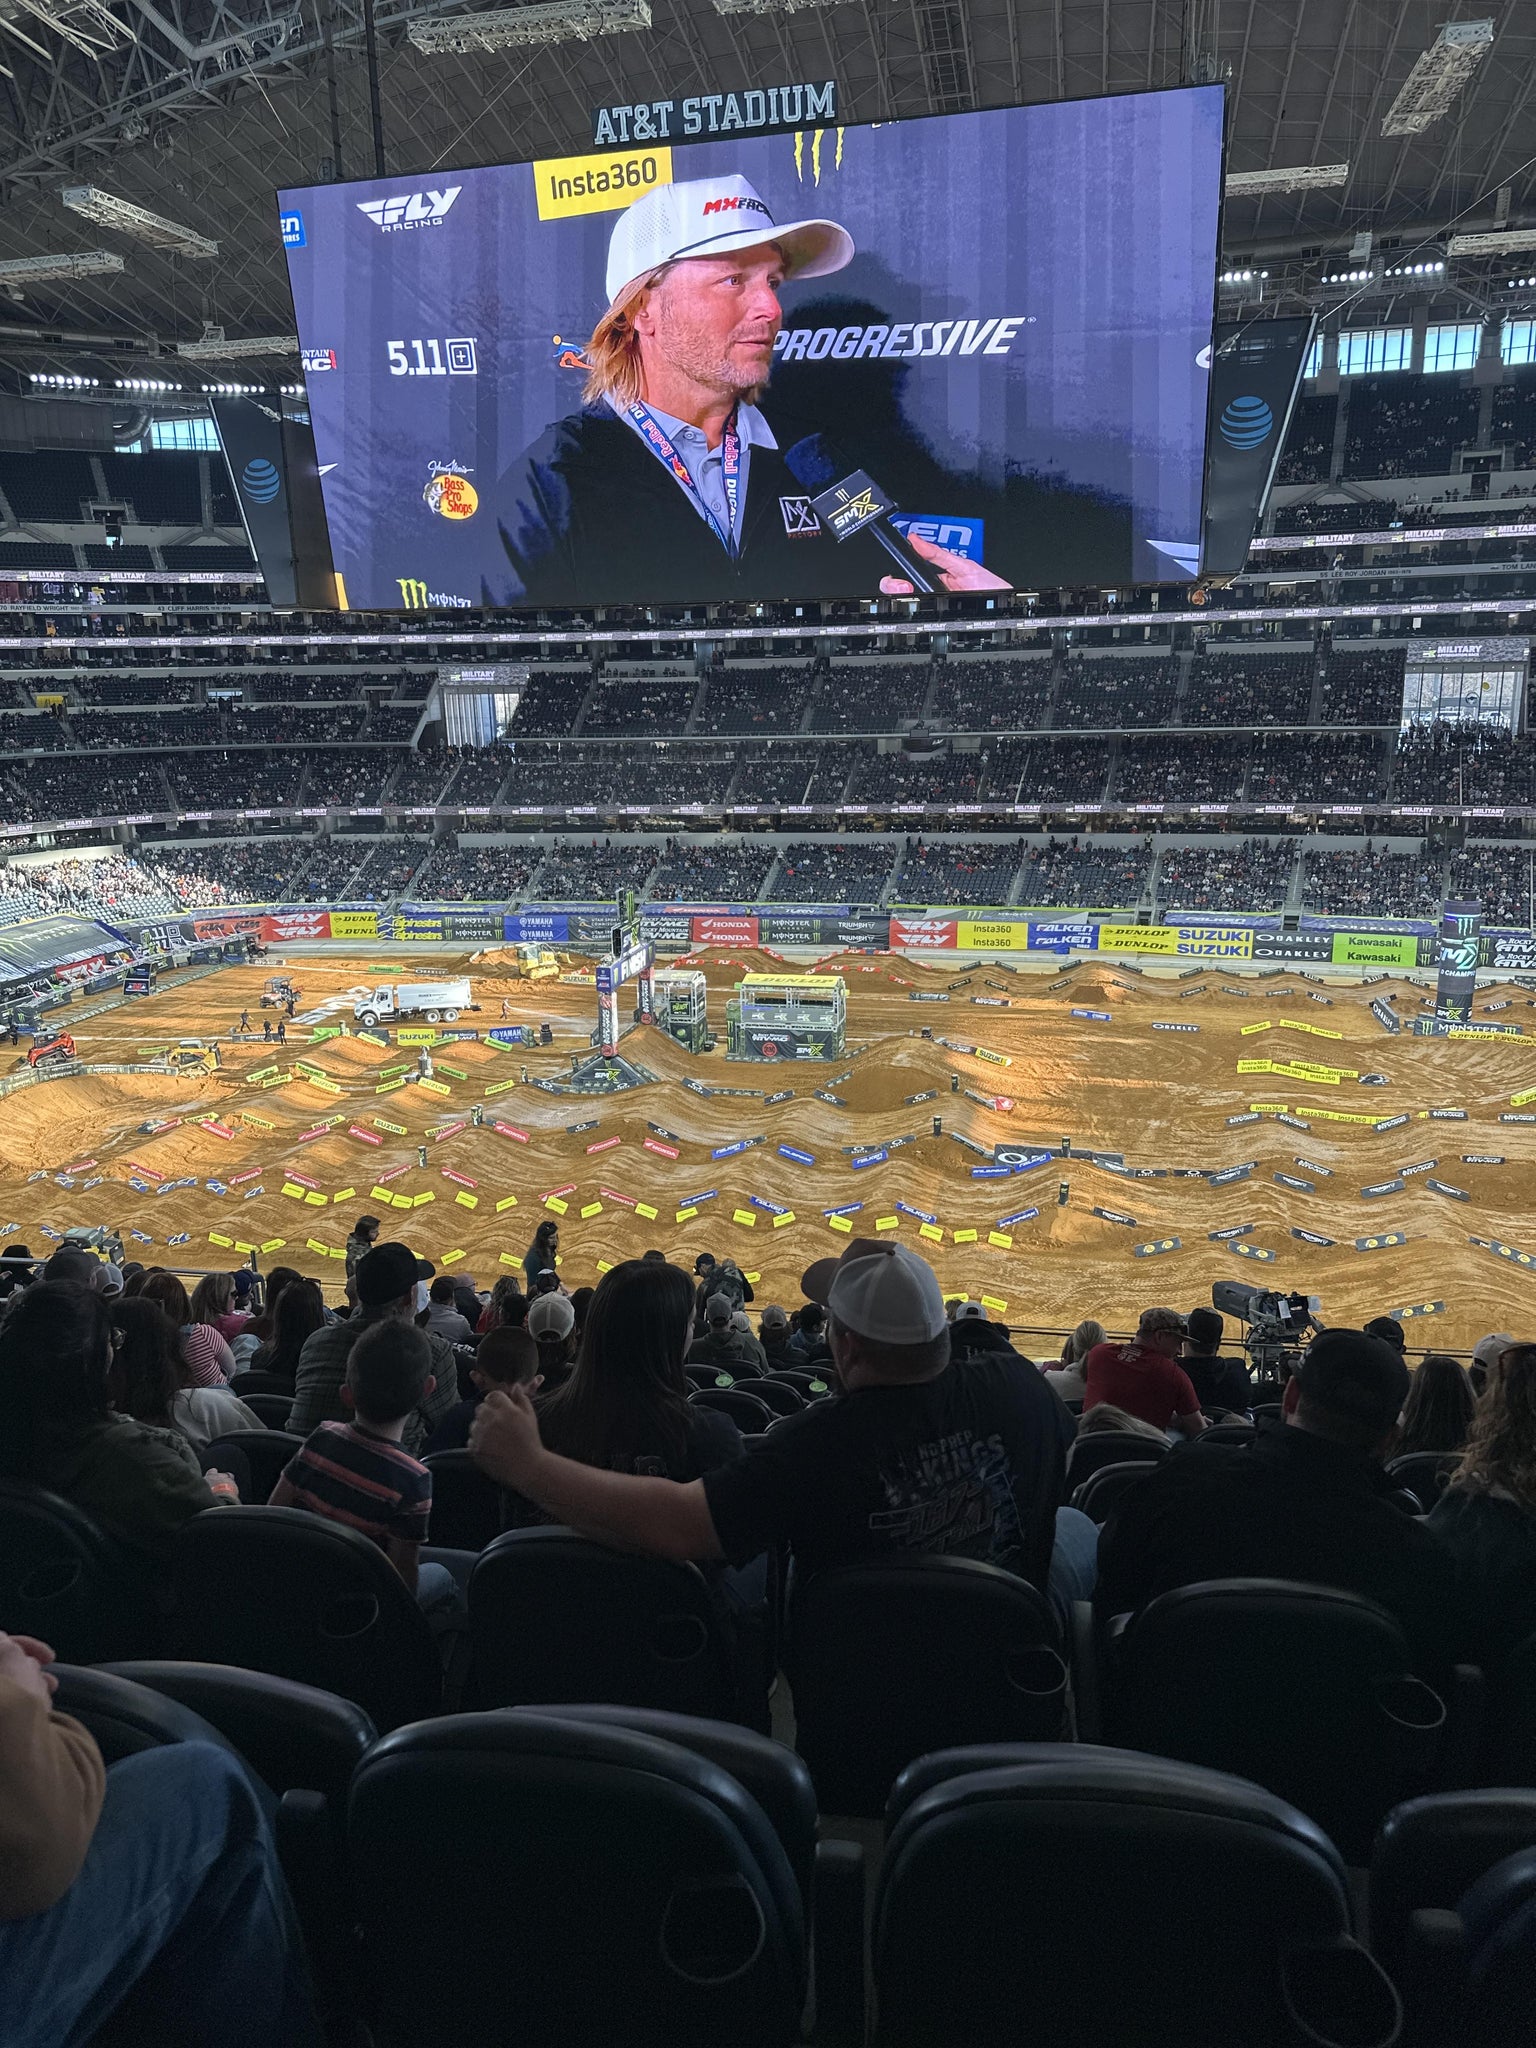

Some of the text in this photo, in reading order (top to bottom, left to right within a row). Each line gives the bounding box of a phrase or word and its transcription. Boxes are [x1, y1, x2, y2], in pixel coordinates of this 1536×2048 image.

[594, 81, 836, 145] AT&T STADIUM
[551, 157, 657, 200] Insta360
[381, 217, 443, 233] RACING
[772, 316, 1025, 361] PROGRESSIVE
[387, 339, 447, 376] 5.11
[444, 477, 465, 491] Bass
[444, 490, 461, 502] Pro
[447, 501, 473, 516] Shops
[834, 492, 880, 529] SMX
[1316, 534, 1355, 542] MILITARY
[1405, 529, 1446, 537] MILITARY
[1437, 645, 1482, 653] MILITARY
[462, 670, 495, 678] MILITARY
[393, 917, 442, 928] alpinestars
[838, 921, 868, 930] TRIUMPH
[1036, 924, 1093, 933] FALKEN
[974, 925, 1011, 933] Insta360
[1115, 929, 1170, 937] DUNLOP
[394, 930, 442, 941] alpinestars
[838, 935, 868, 943] TRIUMPH
[1035, 936, 1091, 944] FALKEN
[1178, 929, 1250, 942] SUZUKI
[1276, 935, 1330, 943] OAKLEY
[973, 938, 1011, 947] Insta360
[1114, 940, 1169, 950] DUNLOP
[1348, 937, 1402, 947] Kawasaki
[1176, 944, 1249, 956] SUZUKI
[1274, 950, 1329, 958] OAKLEY
[1347, 952, 1401, 962] Kawasaki
[621, 949, 647, 980] FINISH
[1164, 1024, 1198, 1032] OAKLEY
[1438, 1023, 1499, 1034] MONSTER
[399, 1032, 434, 1041] SUZUKI
[1501, 1035, 1532, 1044] DUNLOP
[795, 1044, 823, 1056] SMX
[979, 1049, 1004, 1063] SUZUKI
[1275, 1065, 1302, 1075] Insta360
[594, 1071, 620, 1082] SMX
[314, 1078, 338, 1092] SUZUKI
[423, 1079, 448, 1093] SUZUKI
[1301, 1111, 1329, 1119] Insta360
[244, 1115, 271, 1128] SUZUKI
[375, 1121, 404, 1133] SUZUKI
[209, 1125, 230, 1138] HONDA
[357, 1131, 379, 1144] HONDA
[504, 1128, 526, 1140] HONDA
[652, 1143, 676, 1157] HONDA
[716, 1143, 740, 1154] FALKEN
[857, 1152, 882, 1164] FALKEN
[139, 1167, 161, 1180] HONDA
[236, 1171, 259, 1182] HONDA
[294, 1175, 319, 1188] HONDA
[449, 1174, 474, 1188] HONDA
[609, 1192, 635, 1206] HONDA
[755, 1197, 785, 1213] FALKEN
[902, 1204, 932, 1220] FALKEN
